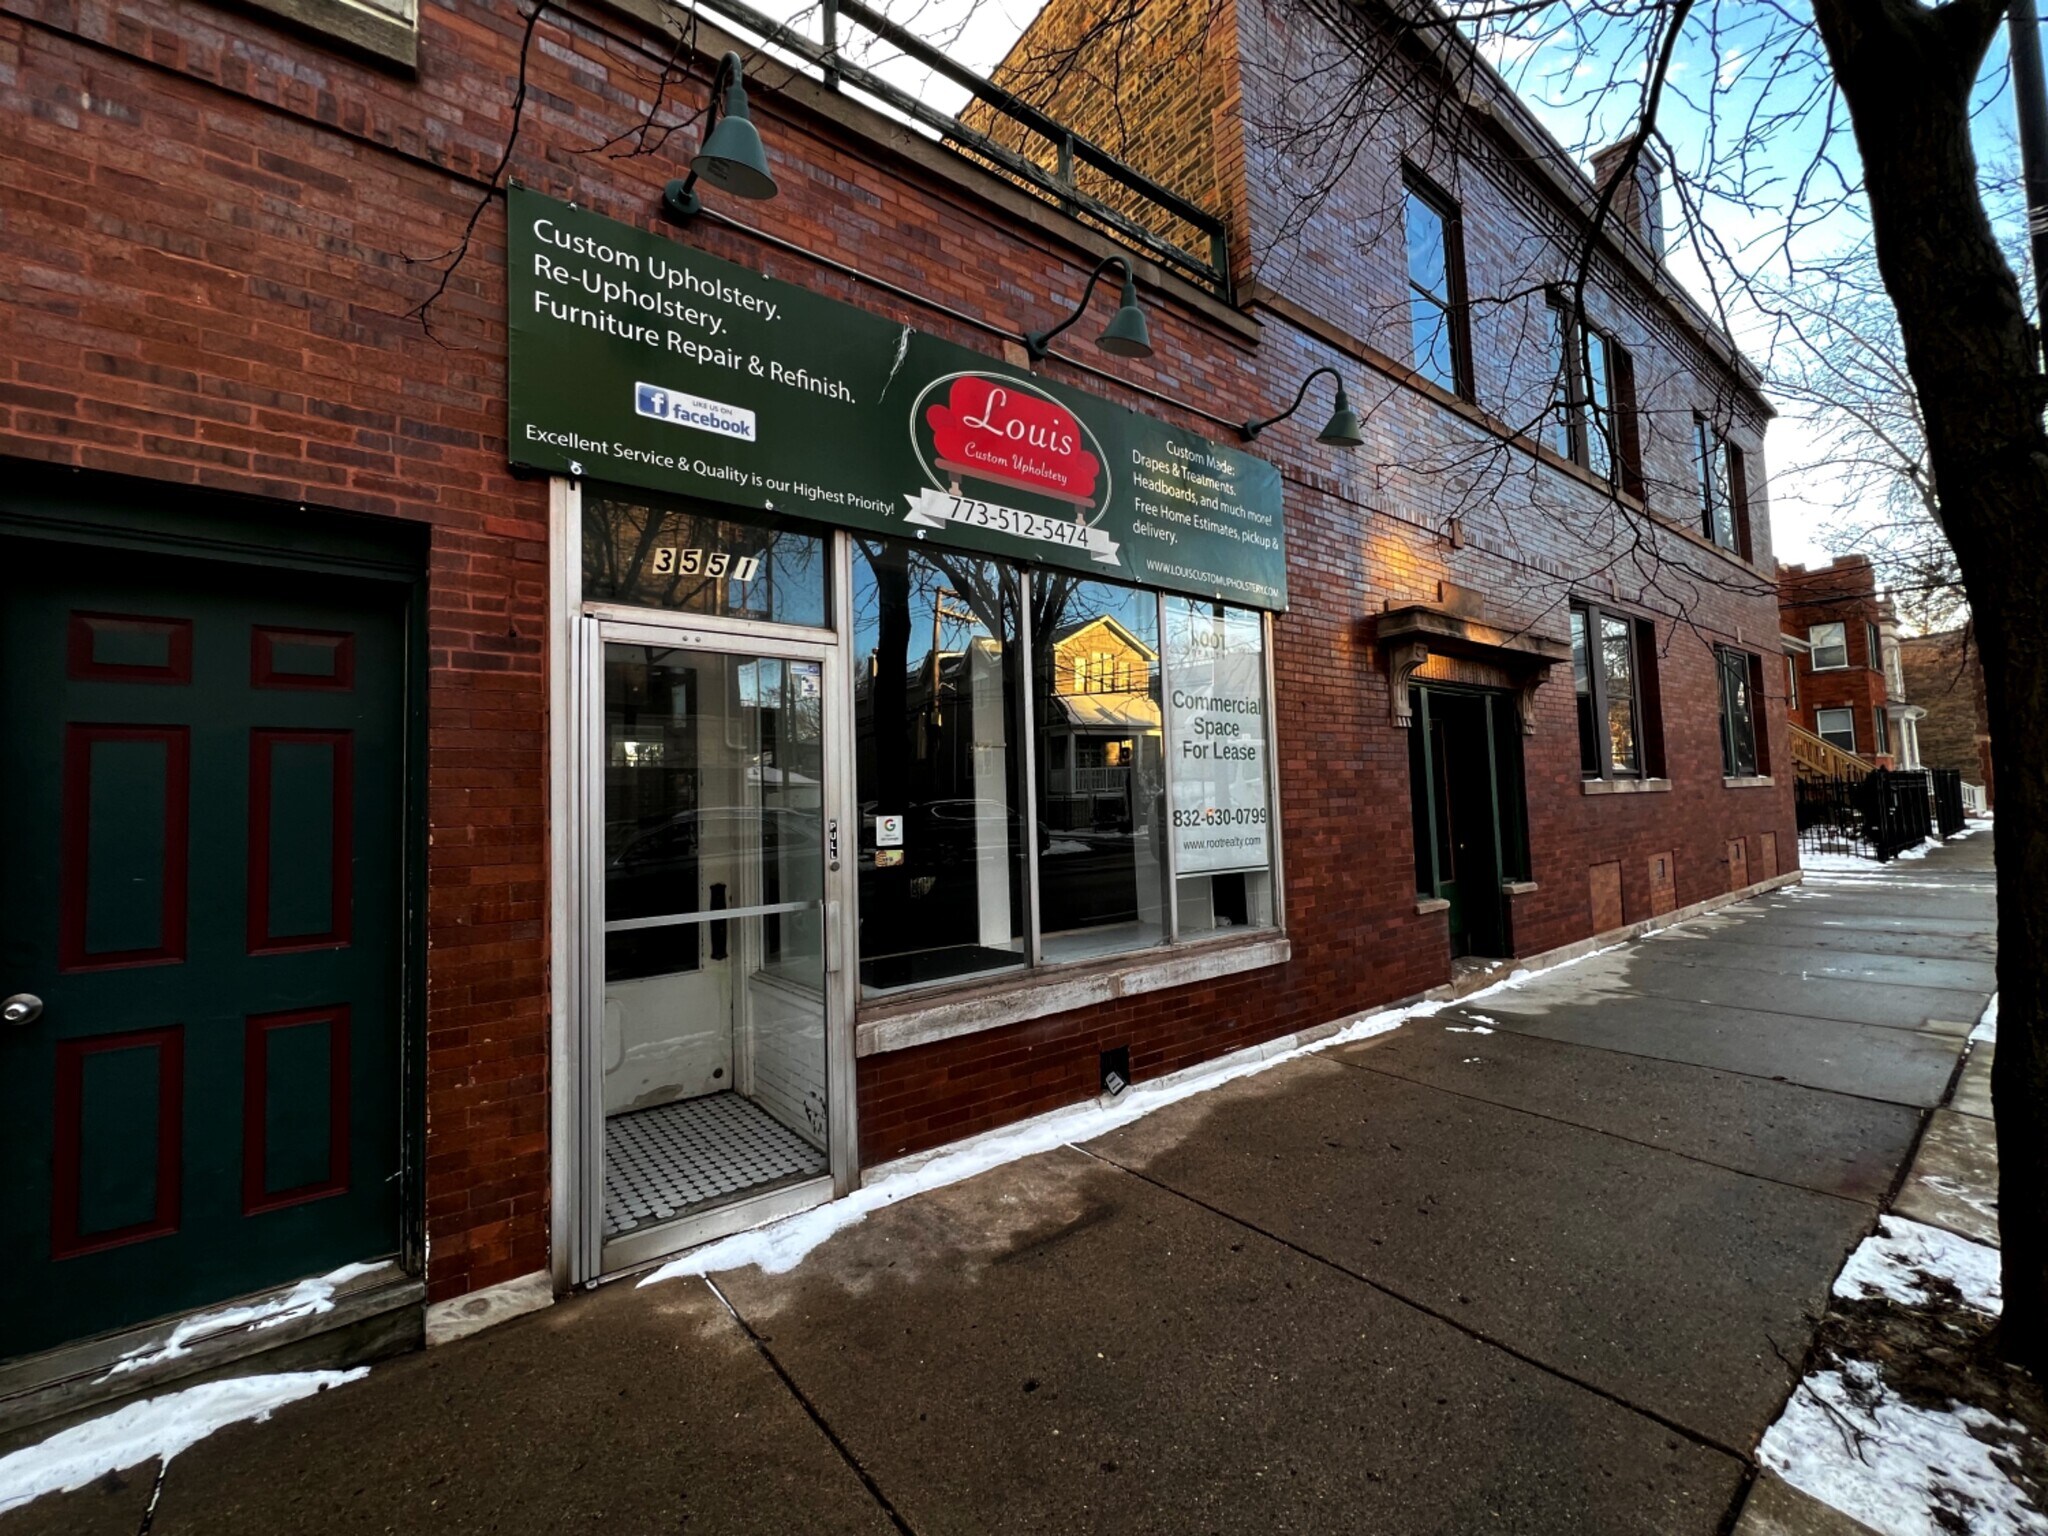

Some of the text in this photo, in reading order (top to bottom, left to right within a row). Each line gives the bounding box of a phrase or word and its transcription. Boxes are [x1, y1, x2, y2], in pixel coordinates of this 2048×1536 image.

[533, 219, 782, 321] Custom Upholstery.
[534, 253, 727, 335] Re-Upholstery.
[535, 291, 856, 403] Furniture Repair & Refinish.
[673, 404, 751, 436] facebook
[709, 404, 719, 412] US
[720, 407, 733, 416] ON
[962, 388, 1073, 455] Louis
[526, 424, 895, 515] Excellent Service & Quality is our Highest Priority!
[965, 441, 1068, 487] Custom Upholstery
[1132, 449, 1236, 496] Drapes & Treatments.
[1166, 440, 1236, 477] Custom Made:
[1133, 472, 1272, 527] Headboards, and much more!
[949, 496, 1089, 547] 773-512-5474
[1132, 519, 1178, 546] delivery.
[1135, 497, 1279, 550] Free Home Estimates, pickup &
[655, 548, 752, 579] 3551
[1172, 690, 1261, 716] Commercial
[1194, 717, 1239, 739] Space
[1183, 741, 1256, 761] For Lease
[1172, 808, 1267, 828] 832-630-0799
[1183, 836, 1261, 851] www.rootrealty.com
